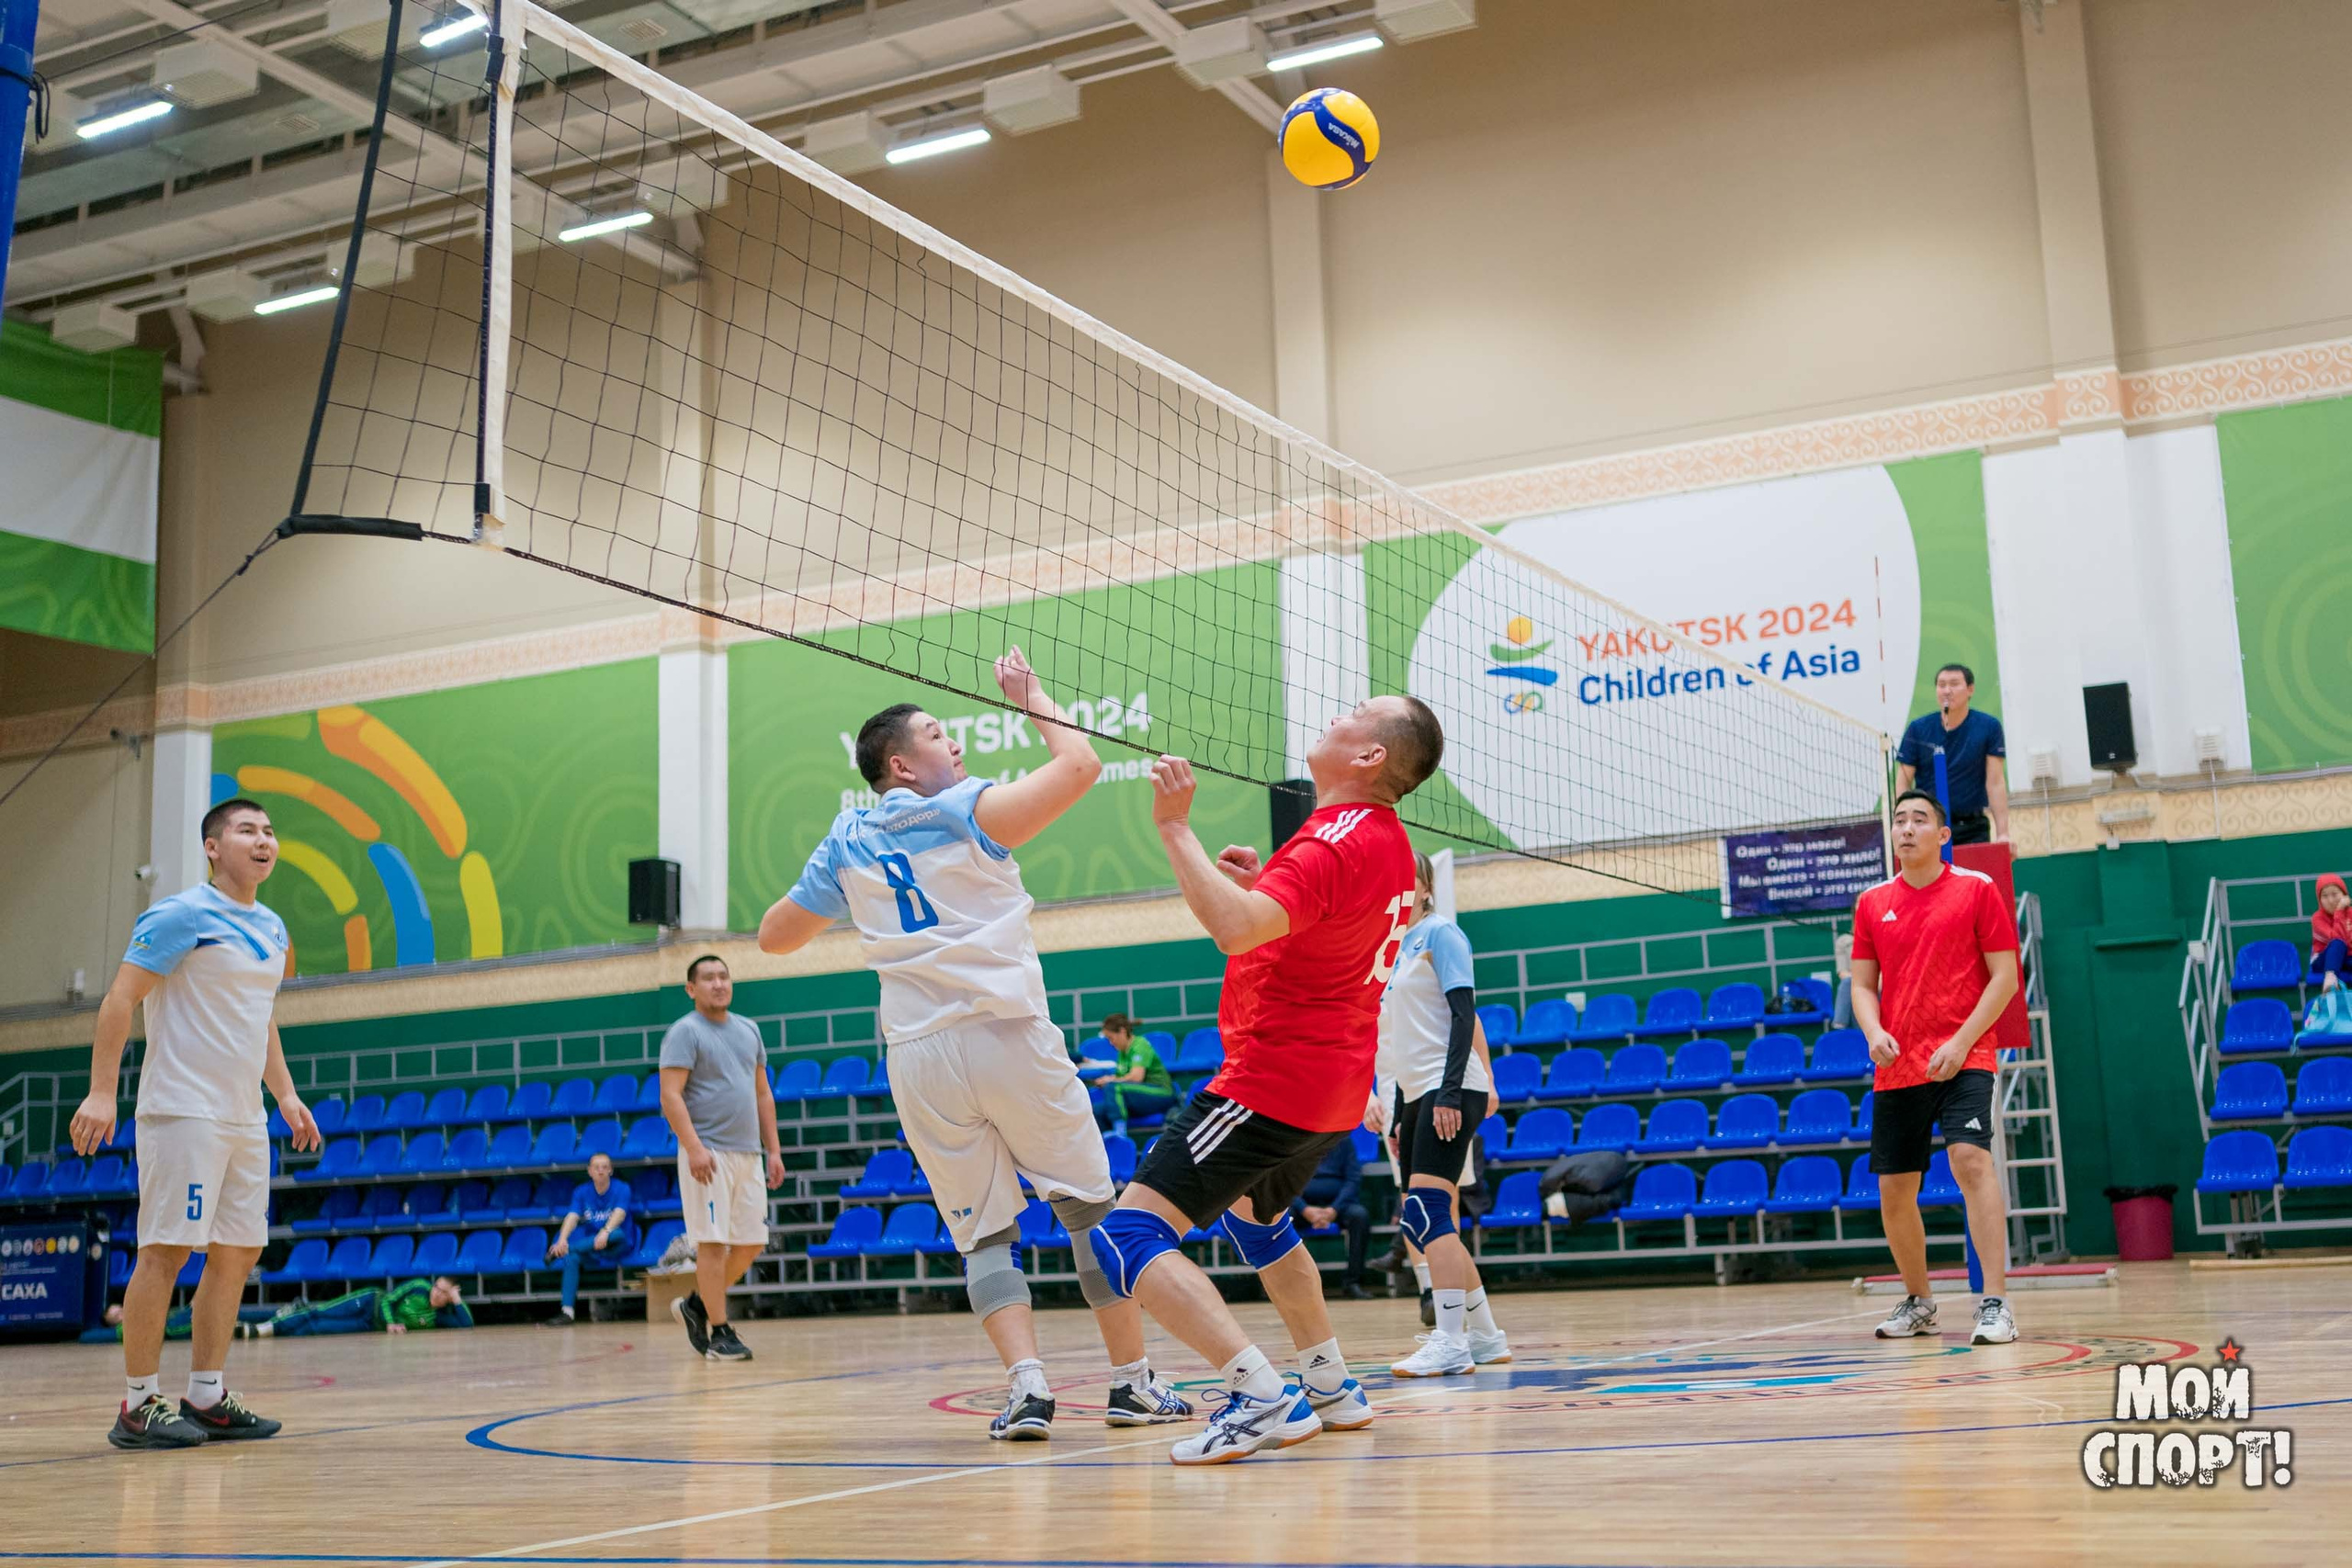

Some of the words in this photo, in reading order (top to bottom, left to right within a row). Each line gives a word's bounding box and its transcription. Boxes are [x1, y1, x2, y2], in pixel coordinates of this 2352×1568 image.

[1578, 616, 1747, 660] YAKUTSK
[1758, 598, 1856, 638] 2024
[1580, 665, 1724, 705] Children
[1781, 644, 1860, 681] Asia
[840, 711, 1031, 770] YTSK
[1040, 692, 1153, 746] 024
[1095, 757, 1153, 784] mes
[1736, 845, 1771, 859] Один
[1766, 856, 1805, 872] Один
[1815, 853, 1840, 867] это
[876, 852, 938, 934] 8
[187, 1183, 202, 1221] 5
[707, 1200, 714, 1224] 1
[2, 1282, 48, 1301] САХА
